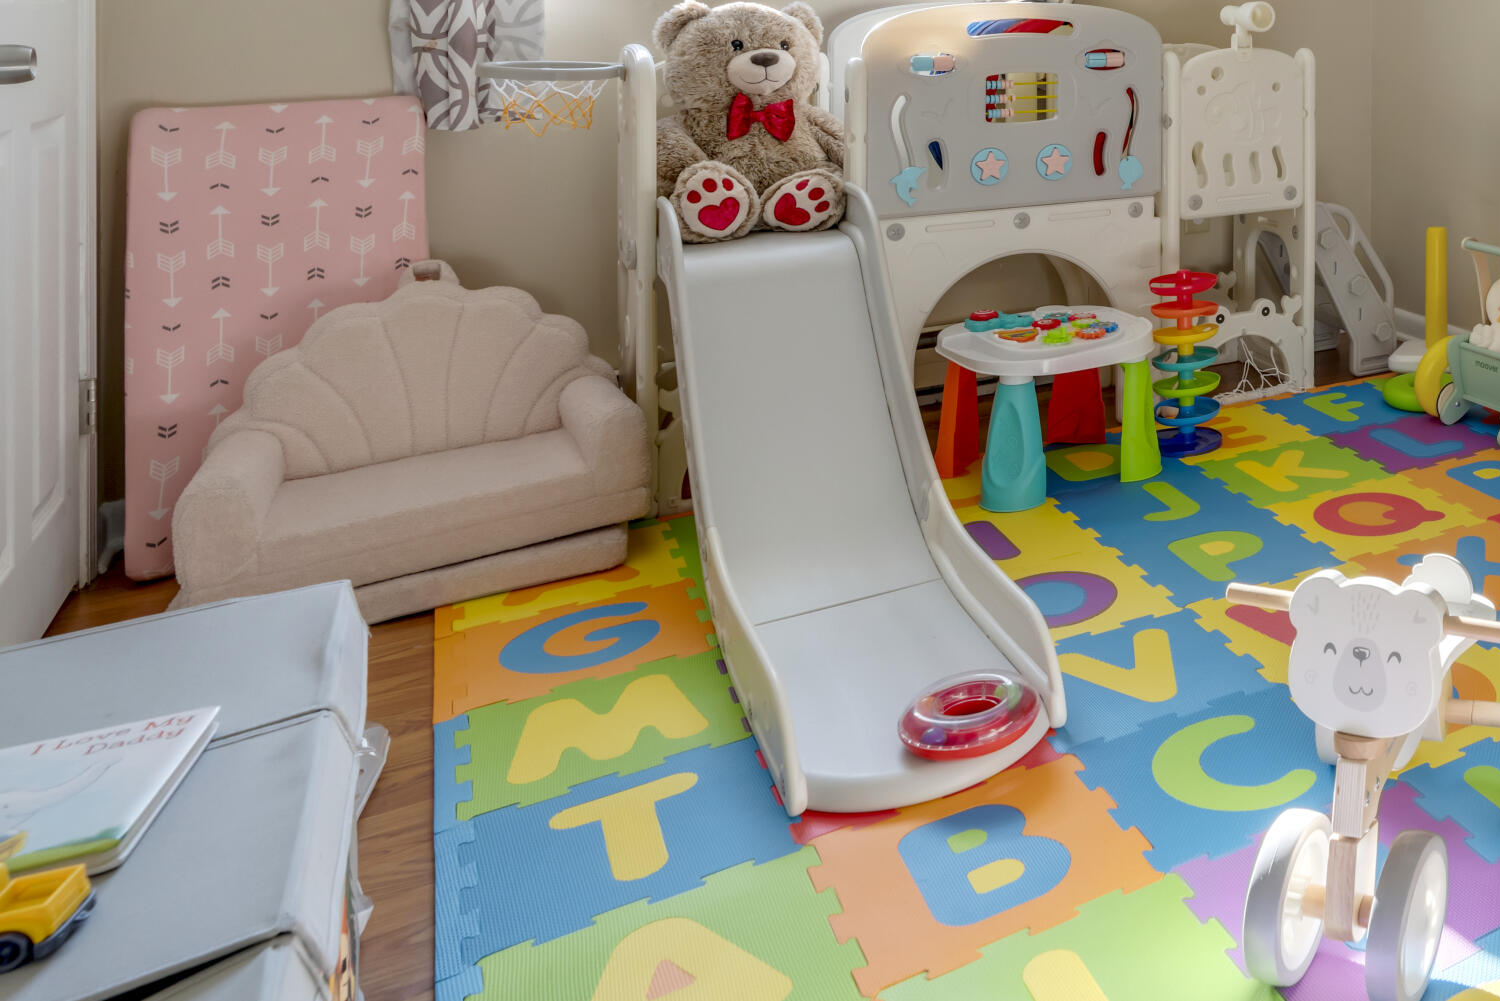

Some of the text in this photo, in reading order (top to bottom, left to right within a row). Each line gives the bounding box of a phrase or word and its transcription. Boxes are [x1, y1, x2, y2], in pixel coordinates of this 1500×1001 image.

[30, 715, 195, 756] I Love My
[83, 727, 185, 756] Daddy
